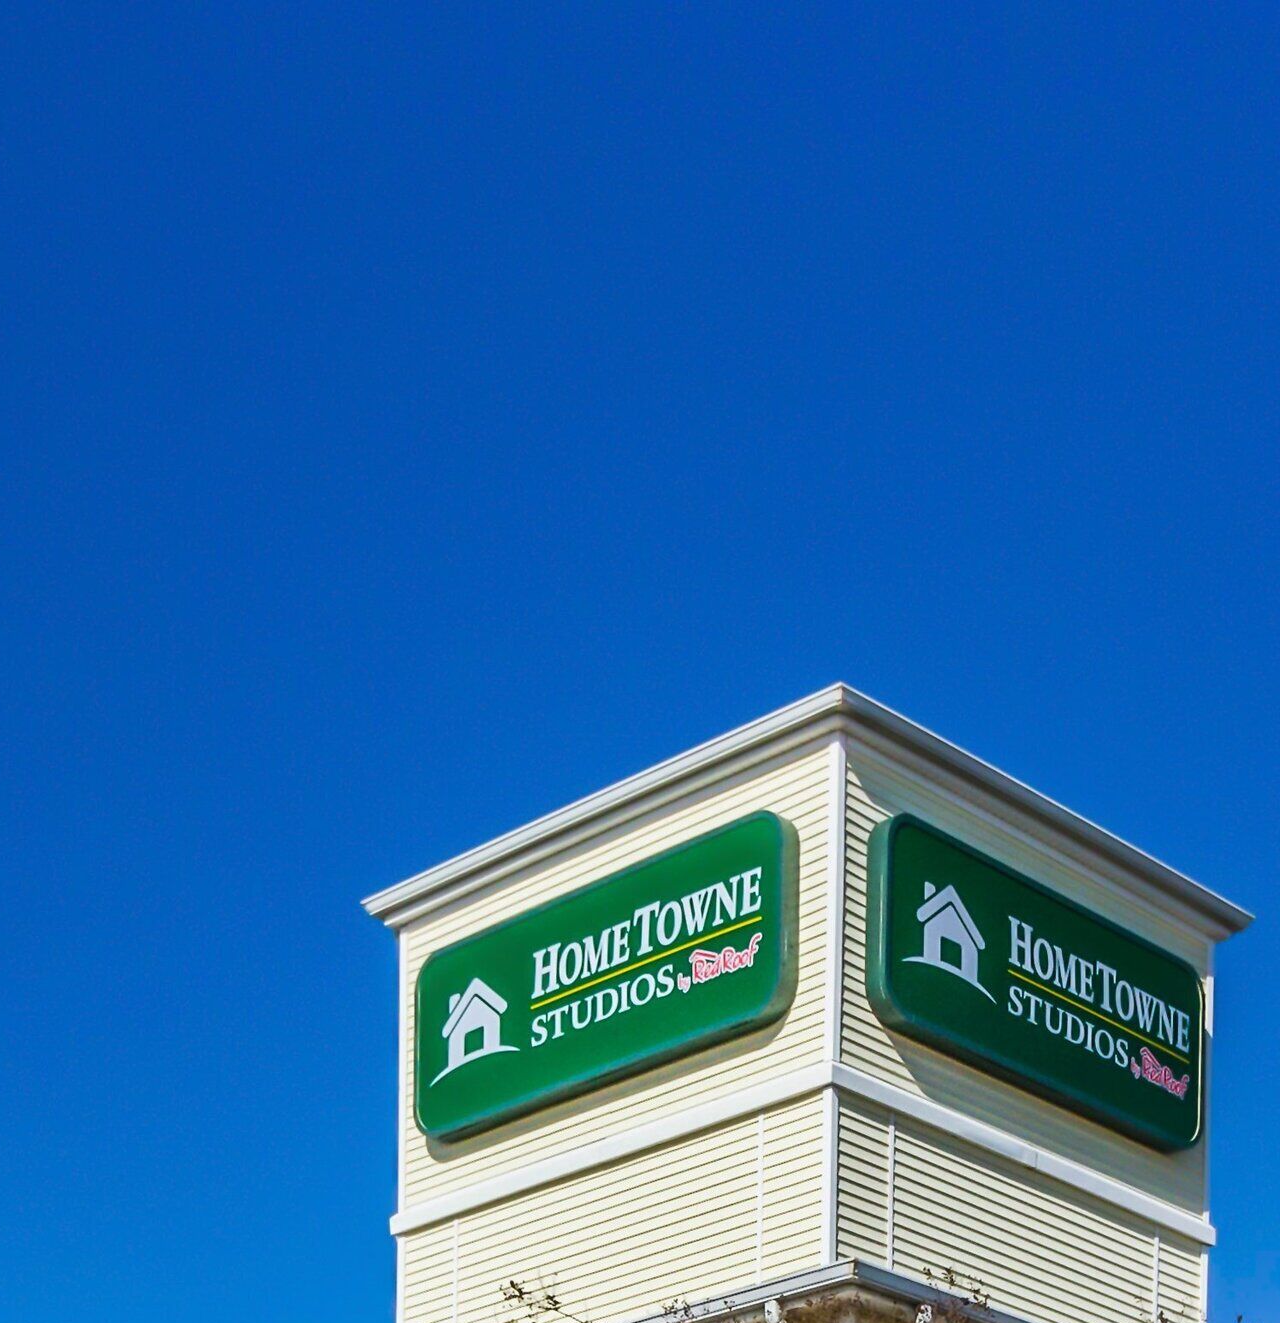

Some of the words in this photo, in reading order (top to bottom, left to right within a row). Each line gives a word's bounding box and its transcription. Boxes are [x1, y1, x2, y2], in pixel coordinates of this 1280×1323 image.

[531, 963, 675, 1048] STUDIOS
[677, 972, 692, 993] by
[721, 931, 763, 974] Roof
[1007, 985, 1129, 1069] STUDIOS
